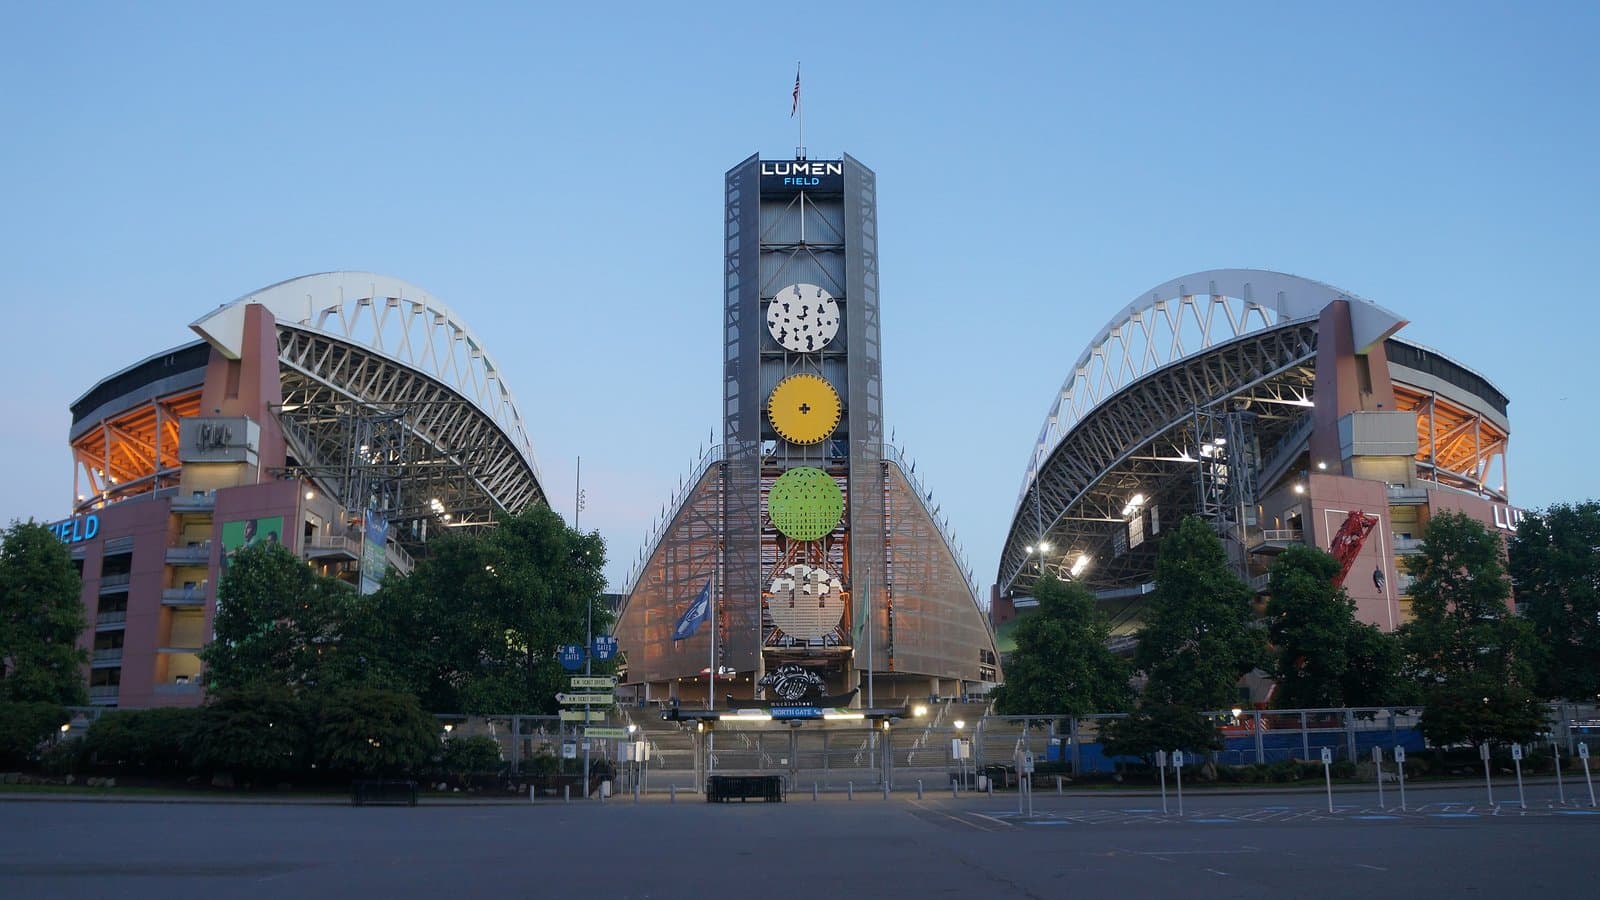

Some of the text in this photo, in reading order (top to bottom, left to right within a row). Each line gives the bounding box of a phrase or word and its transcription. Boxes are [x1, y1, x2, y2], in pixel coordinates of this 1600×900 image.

[761, 163, 842, 175] LUMEN
[784, 177, 820, 185] FIELD
[568, 646, 575, 654] NE
